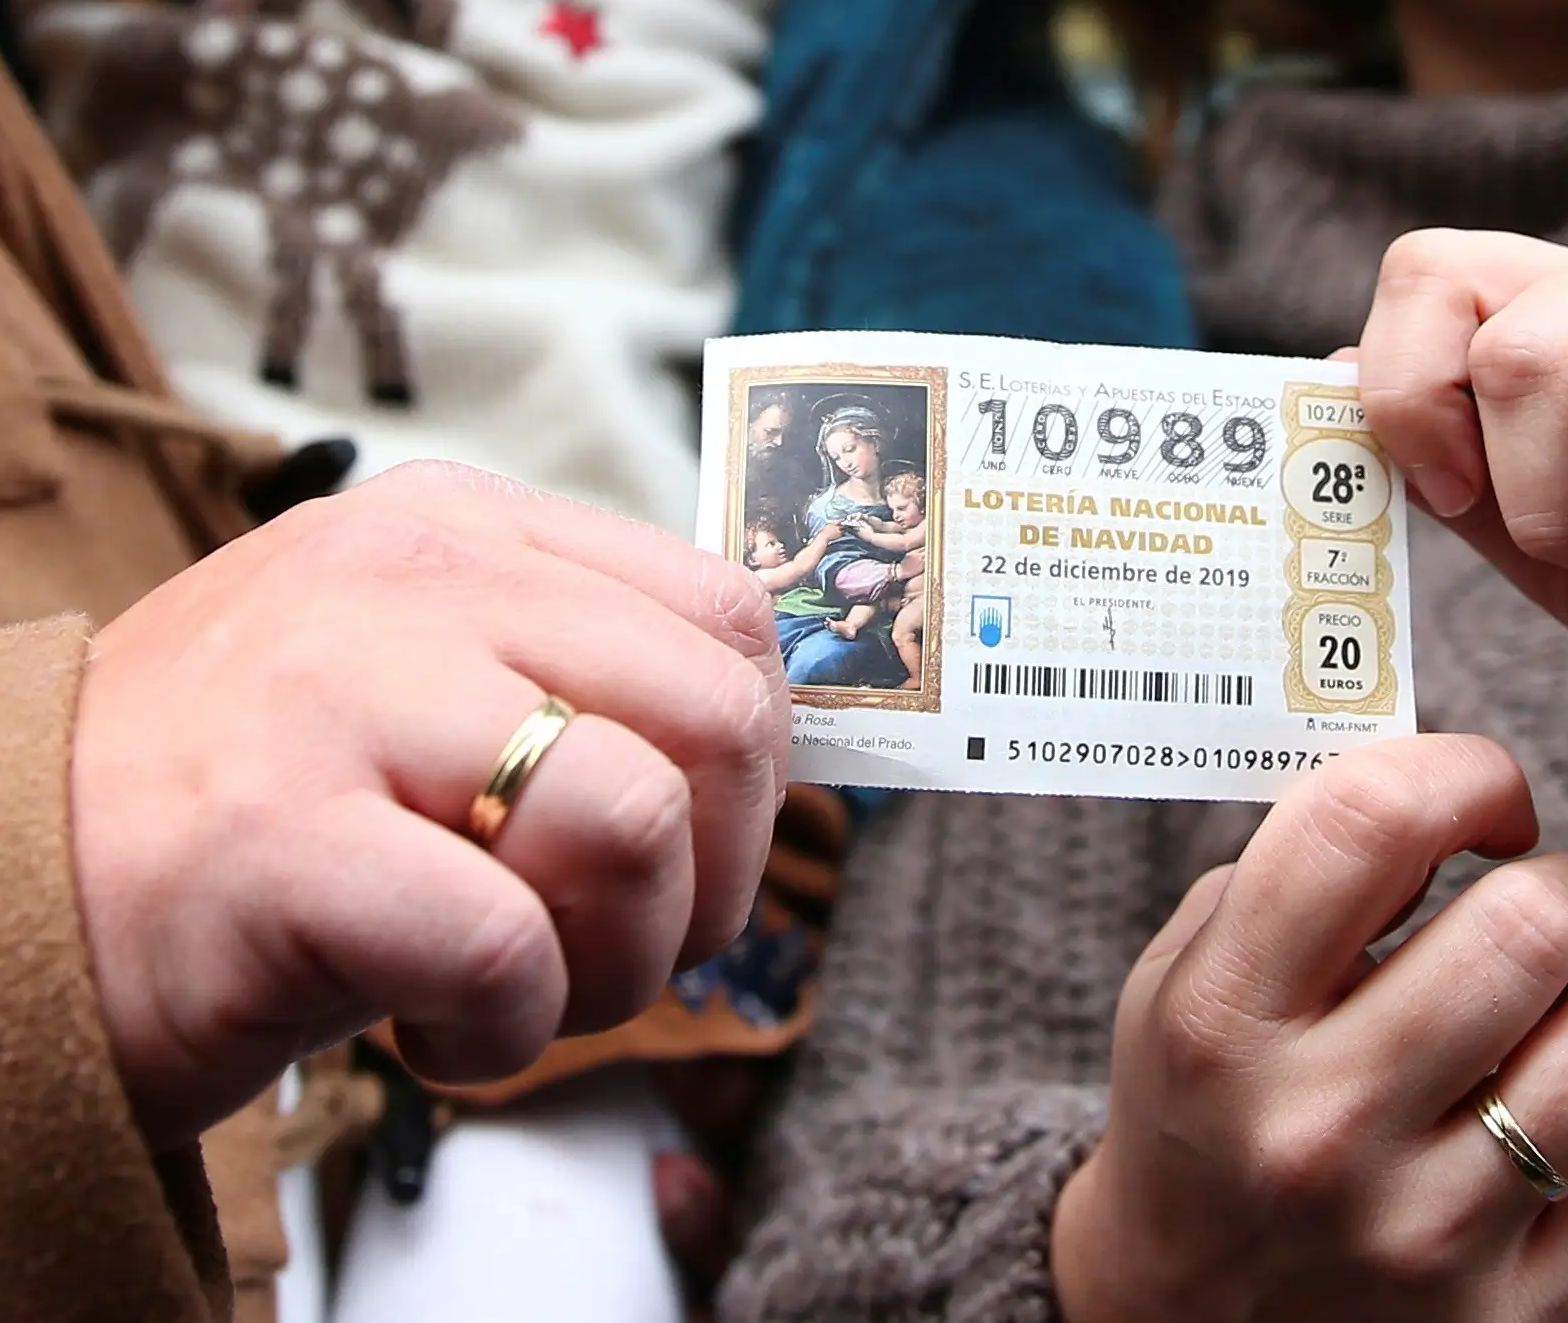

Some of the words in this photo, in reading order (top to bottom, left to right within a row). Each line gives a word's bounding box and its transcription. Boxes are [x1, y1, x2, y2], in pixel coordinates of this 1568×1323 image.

[1306, 403, 1366, 424] 102/19
[977, 397, 1267, 474] 10989
[982, 460, 1007, 471] UNO
[1041, 463, 1072, 477] CERO
[1100, 467, 1139, 480] NUEVE
[963, 488, 1100, 516] LOTERÍA
[1109, 496, 1268, 527] NACIONAL
[1321, 510, 1354, 525] SERIE
[1018, 523, 1060, 547] DE
[1070, 526, 1214, 556] NAVIDAD
[980, 554, 1008, 575] 22
[1014, 556, 1042, 577] de
[1048, 558, 1158, 583] diciembre
[1164, 564, 1192, 585] de
[1198, 566, 1251, 587] 2019
[1306, 570, 1370, 587] FRACCIÓN
[1073, 597, 1086, 606] EL
[1317, 613, 1363, 628] PRECIO
[1318, 634, 1362, 671] 20
[1319, 678, 1365, 691] EUROS
[804, 713, 838, 727] Rosa.
[802, 733, 854, 748] Nacional
[856, 737, 876, 749] del
[878, 736, 916, 751] Prado.
[1007, 739, 1340, 772] 5102907028>01098976
